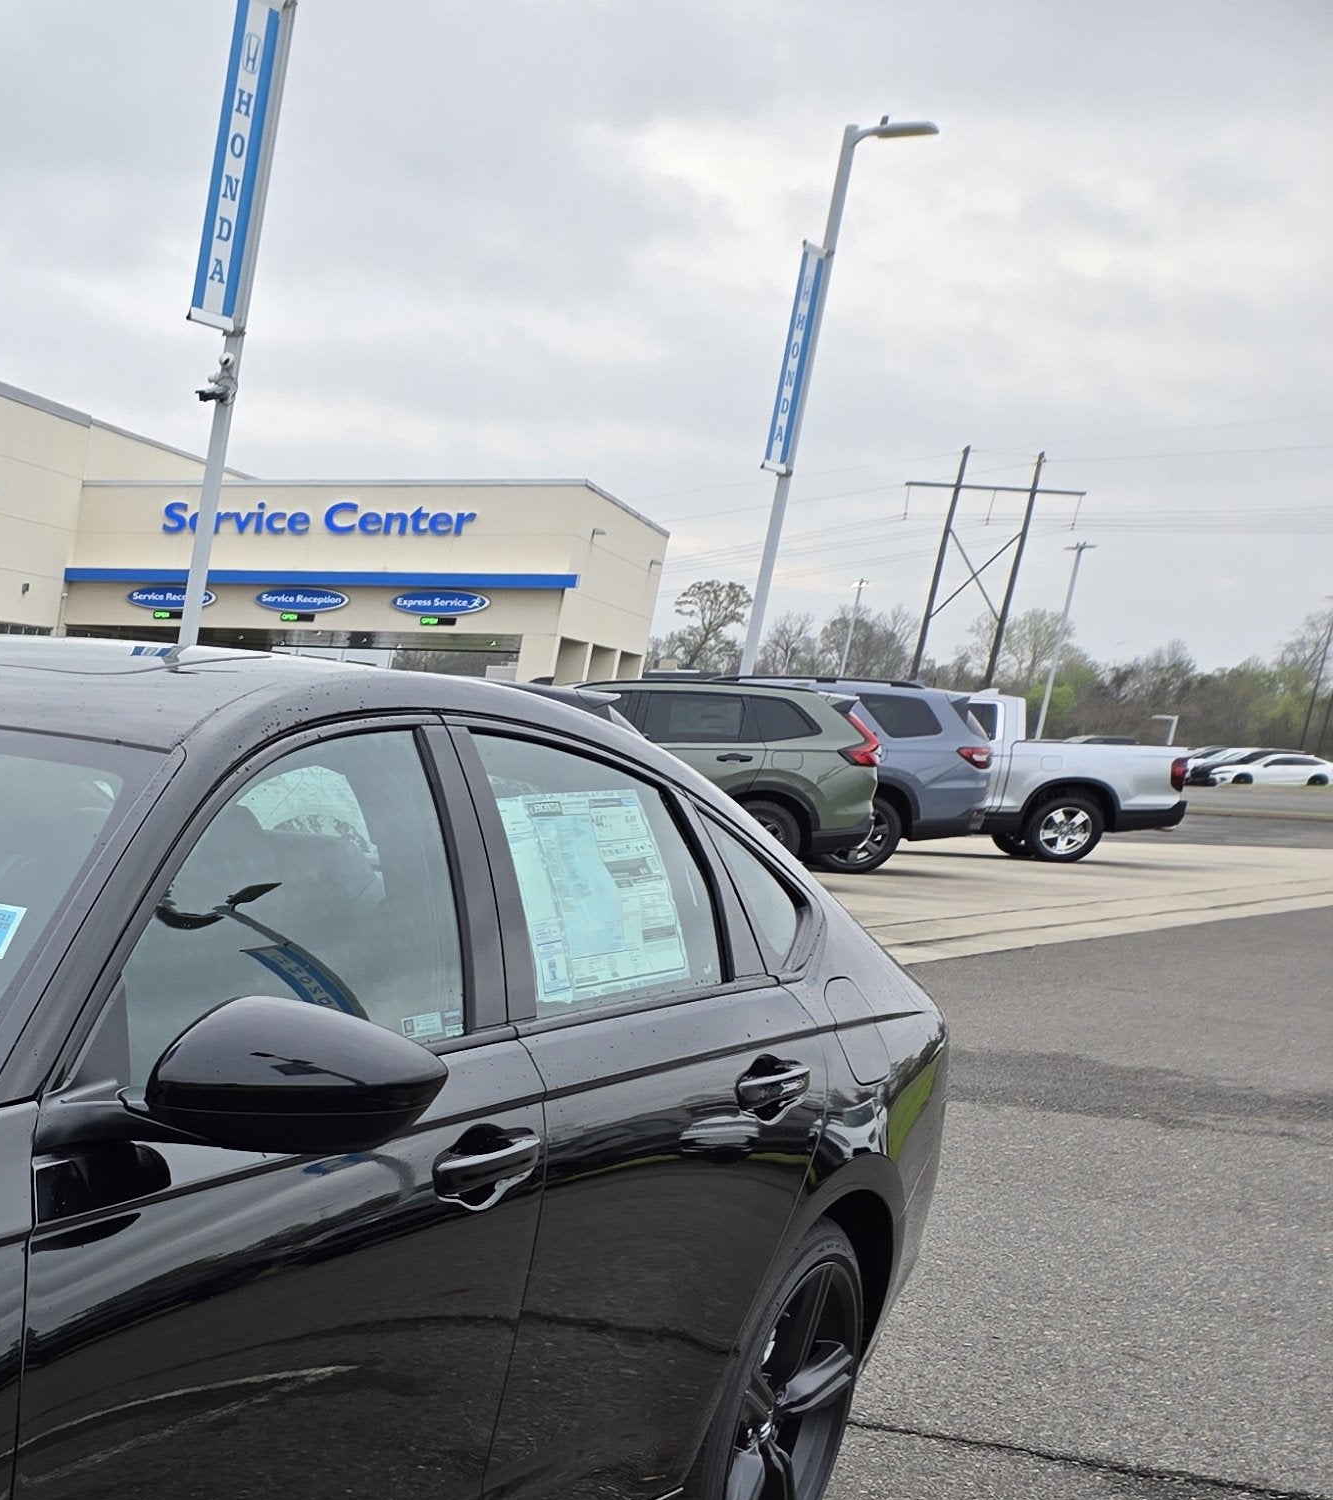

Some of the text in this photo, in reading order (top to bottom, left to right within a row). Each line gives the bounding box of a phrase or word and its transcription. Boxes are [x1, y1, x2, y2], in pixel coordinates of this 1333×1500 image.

[209, 88, 254, 284] HONDA
[774, 313, 806, 442] HONDA
[324, 502, 478, 536] Center
[133, 592, 164, 601] Service
[261, 594, 341, 606] Service Reception
[396, 598, 468, 608] Express Service
